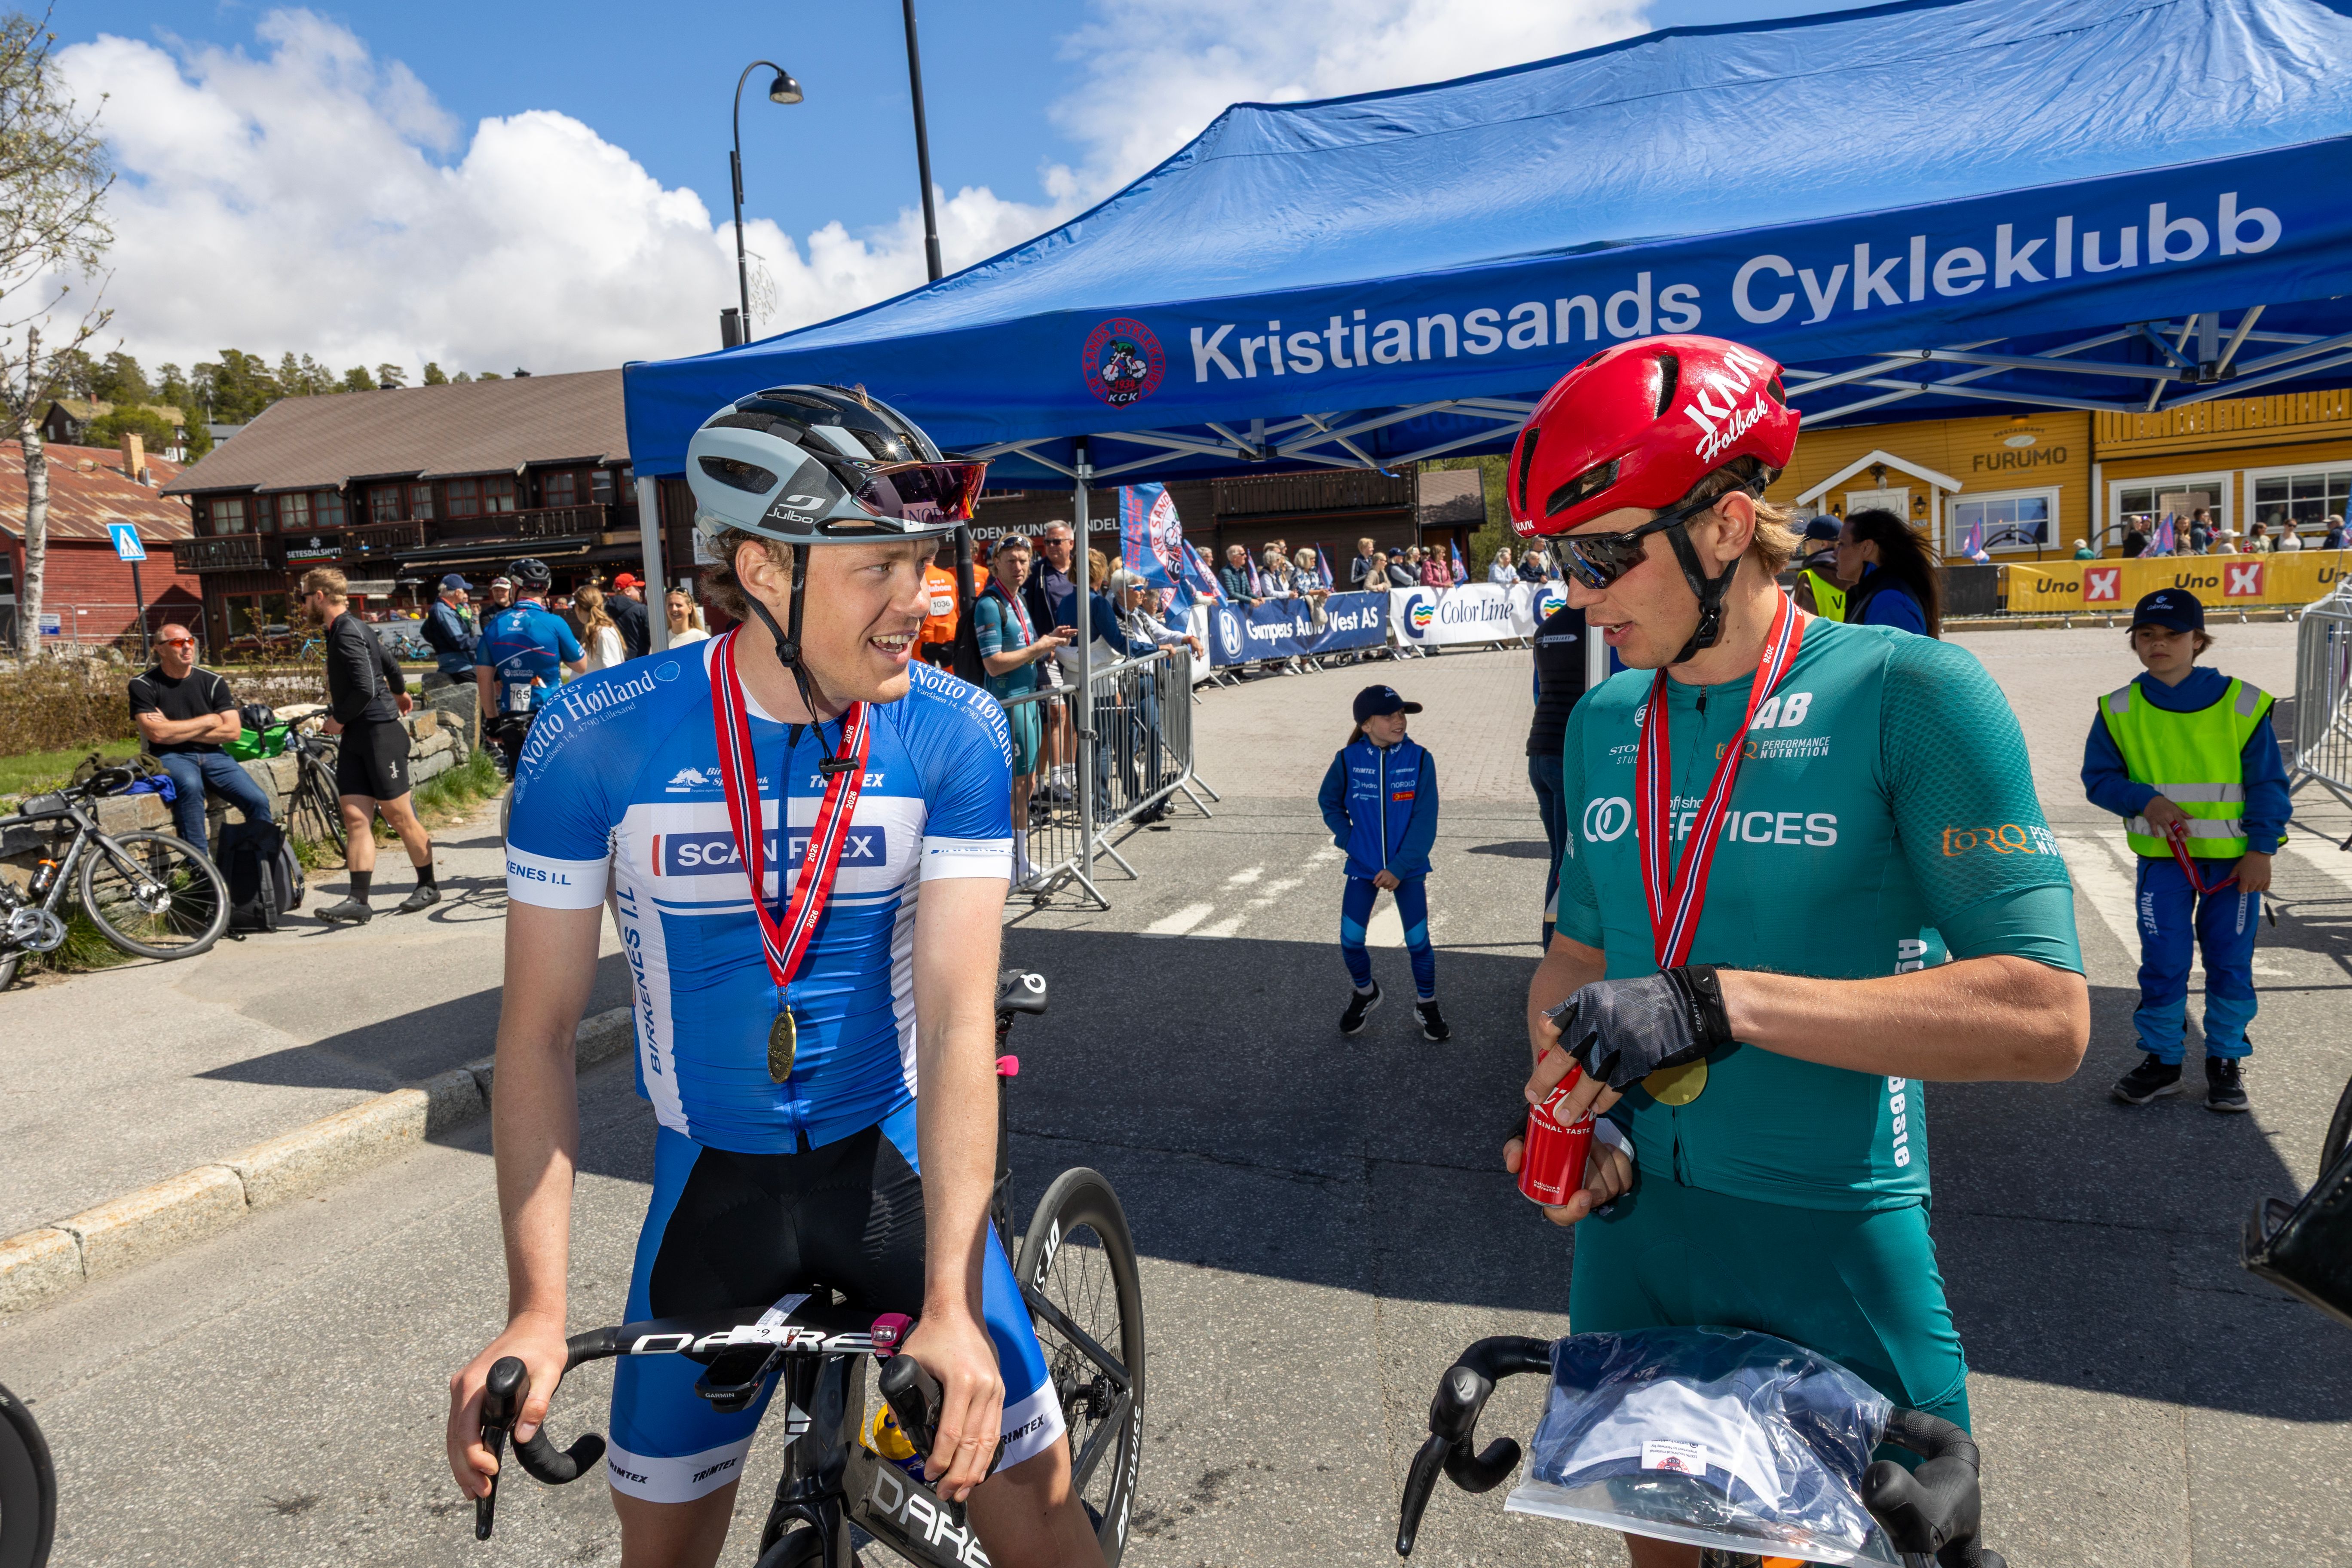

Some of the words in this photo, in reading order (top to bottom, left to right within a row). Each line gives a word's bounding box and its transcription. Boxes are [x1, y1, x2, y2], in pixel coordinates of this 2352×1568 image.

[1191, 272, 1701, 382] Kristiansands
[1731, 192, 2282, 325] Cykleklubb
[1087, 326, 1110, 371] SANDS
[1115, 322, 1163, 391] CYKLEKLUBB
[1090, 375, 1107, 395] KR
[1108, 393, 1138, 402] KCK
[1973, 447, 2067, 472] FURUMO
[766, 508, 814, 524] Julbo
[946, 526, 1006, 542] HVDEN
[1014, 518, 1120, 537] KUNSNDEL
[1168, 560, 1180, 574] KC
[2174, 573, 2219, 588] Uno
[2229, 564, 2260, 594] X
[2036, 578, 2079, 593] Uno
[2089, 570, 2118, 599] X
[1330, 611, 1358, 632] Vest
[1361, 606, 1379, 629] AS
[1442, 600, 1479, 624] Color
[1480, 598, 1513, 621] Line
[1763, 644, 1774, 664] 2026
[521, 714, 564, 775] Notto
[562, 670, 656, 721] Høiland
[910, 667, 966, 699] Notto
[968, 690, 1013, 768] Høiland
[917, 689, 946, 704] Vardåsen
[949, 700, 958, 710] 14,
[961, 705, 978, 720] 4790
[977, 718, 998, 749] Lillesand
[539, 742, 564, 773] Vardåsen
[564, 732, 577, 742] 14,
[579, 718, 600, 733] 4790
[599, 701, 636, 722] Lillesand
[843, 725, 854, 744] 2026
[1762, 736, 1831, 749] PERFORMANCE
[1617, 756, 1638, 765] STUD
[1760, 746, 1829, 759] NUTRITION
[810, 774, 884, 787] TREX
[846, 790, 858, 810] 2026
[1669, 796, 1702, 810] offsho
[1635, 811, 1838, 847] ERVICES
[807, 843, 819, 863] 2026
[507, 860, 547, 882] KENES
[552, 873, 571, 885] I.L
[806, 909, 819, 928] 2026
[2141, 891, 2159, 936] TRIMTEX
[2238, 894, 2247, 927] VINDBJAR
[625, 925, 663, 1076] BIRKENES
[1692, 1003, 1702, 1032] CRAFT
[1529, 1112, 1562, 1133] ORIGINAL
[1534, 1180, 1556, 1190] Delicious
[1534, 1184, 1560, 1194] Refreshing
[1000, 1414, 1044, 1445] RIMTEX
[608, 1456, 649, 1484] TRIMTEX
[692, 1457, 738, 1483] TRIMTEX
[1118, 1492, 1128, 1548] DT
[1128, 1406, 1141, 1496] SWISS
[872, 1466, 992, 1568] DARE
